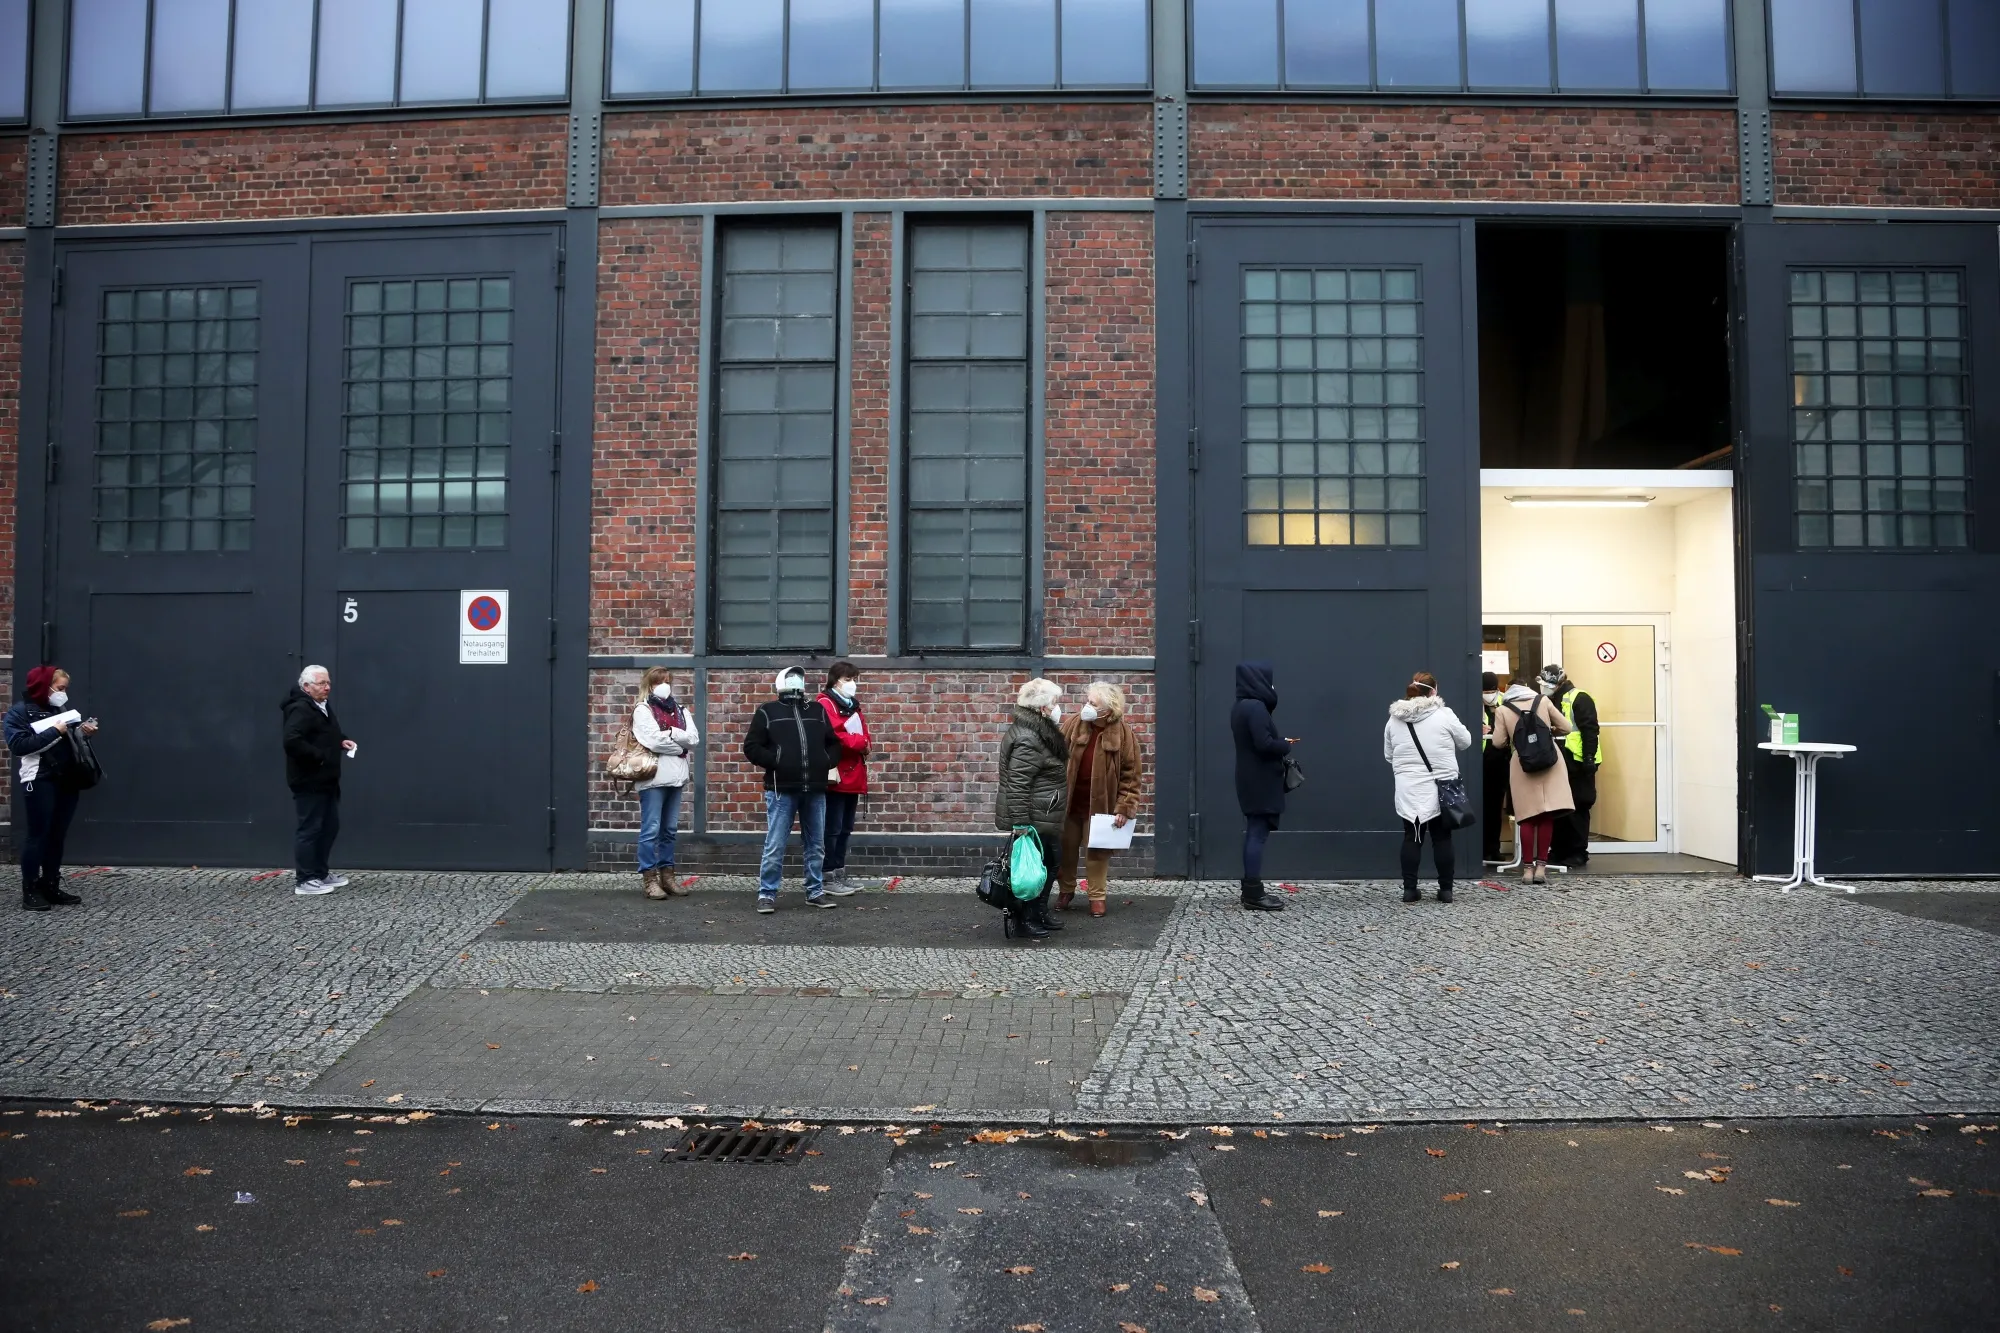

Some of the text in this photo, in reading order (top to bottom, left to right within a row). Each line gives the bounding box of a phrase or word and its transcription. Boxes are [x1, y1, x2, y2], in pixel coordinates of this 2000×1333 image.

[343, 601, 358, 623] 5
[463, 640, 505, 648] Notausgang
[467, 649, 501, 657] freihalten
